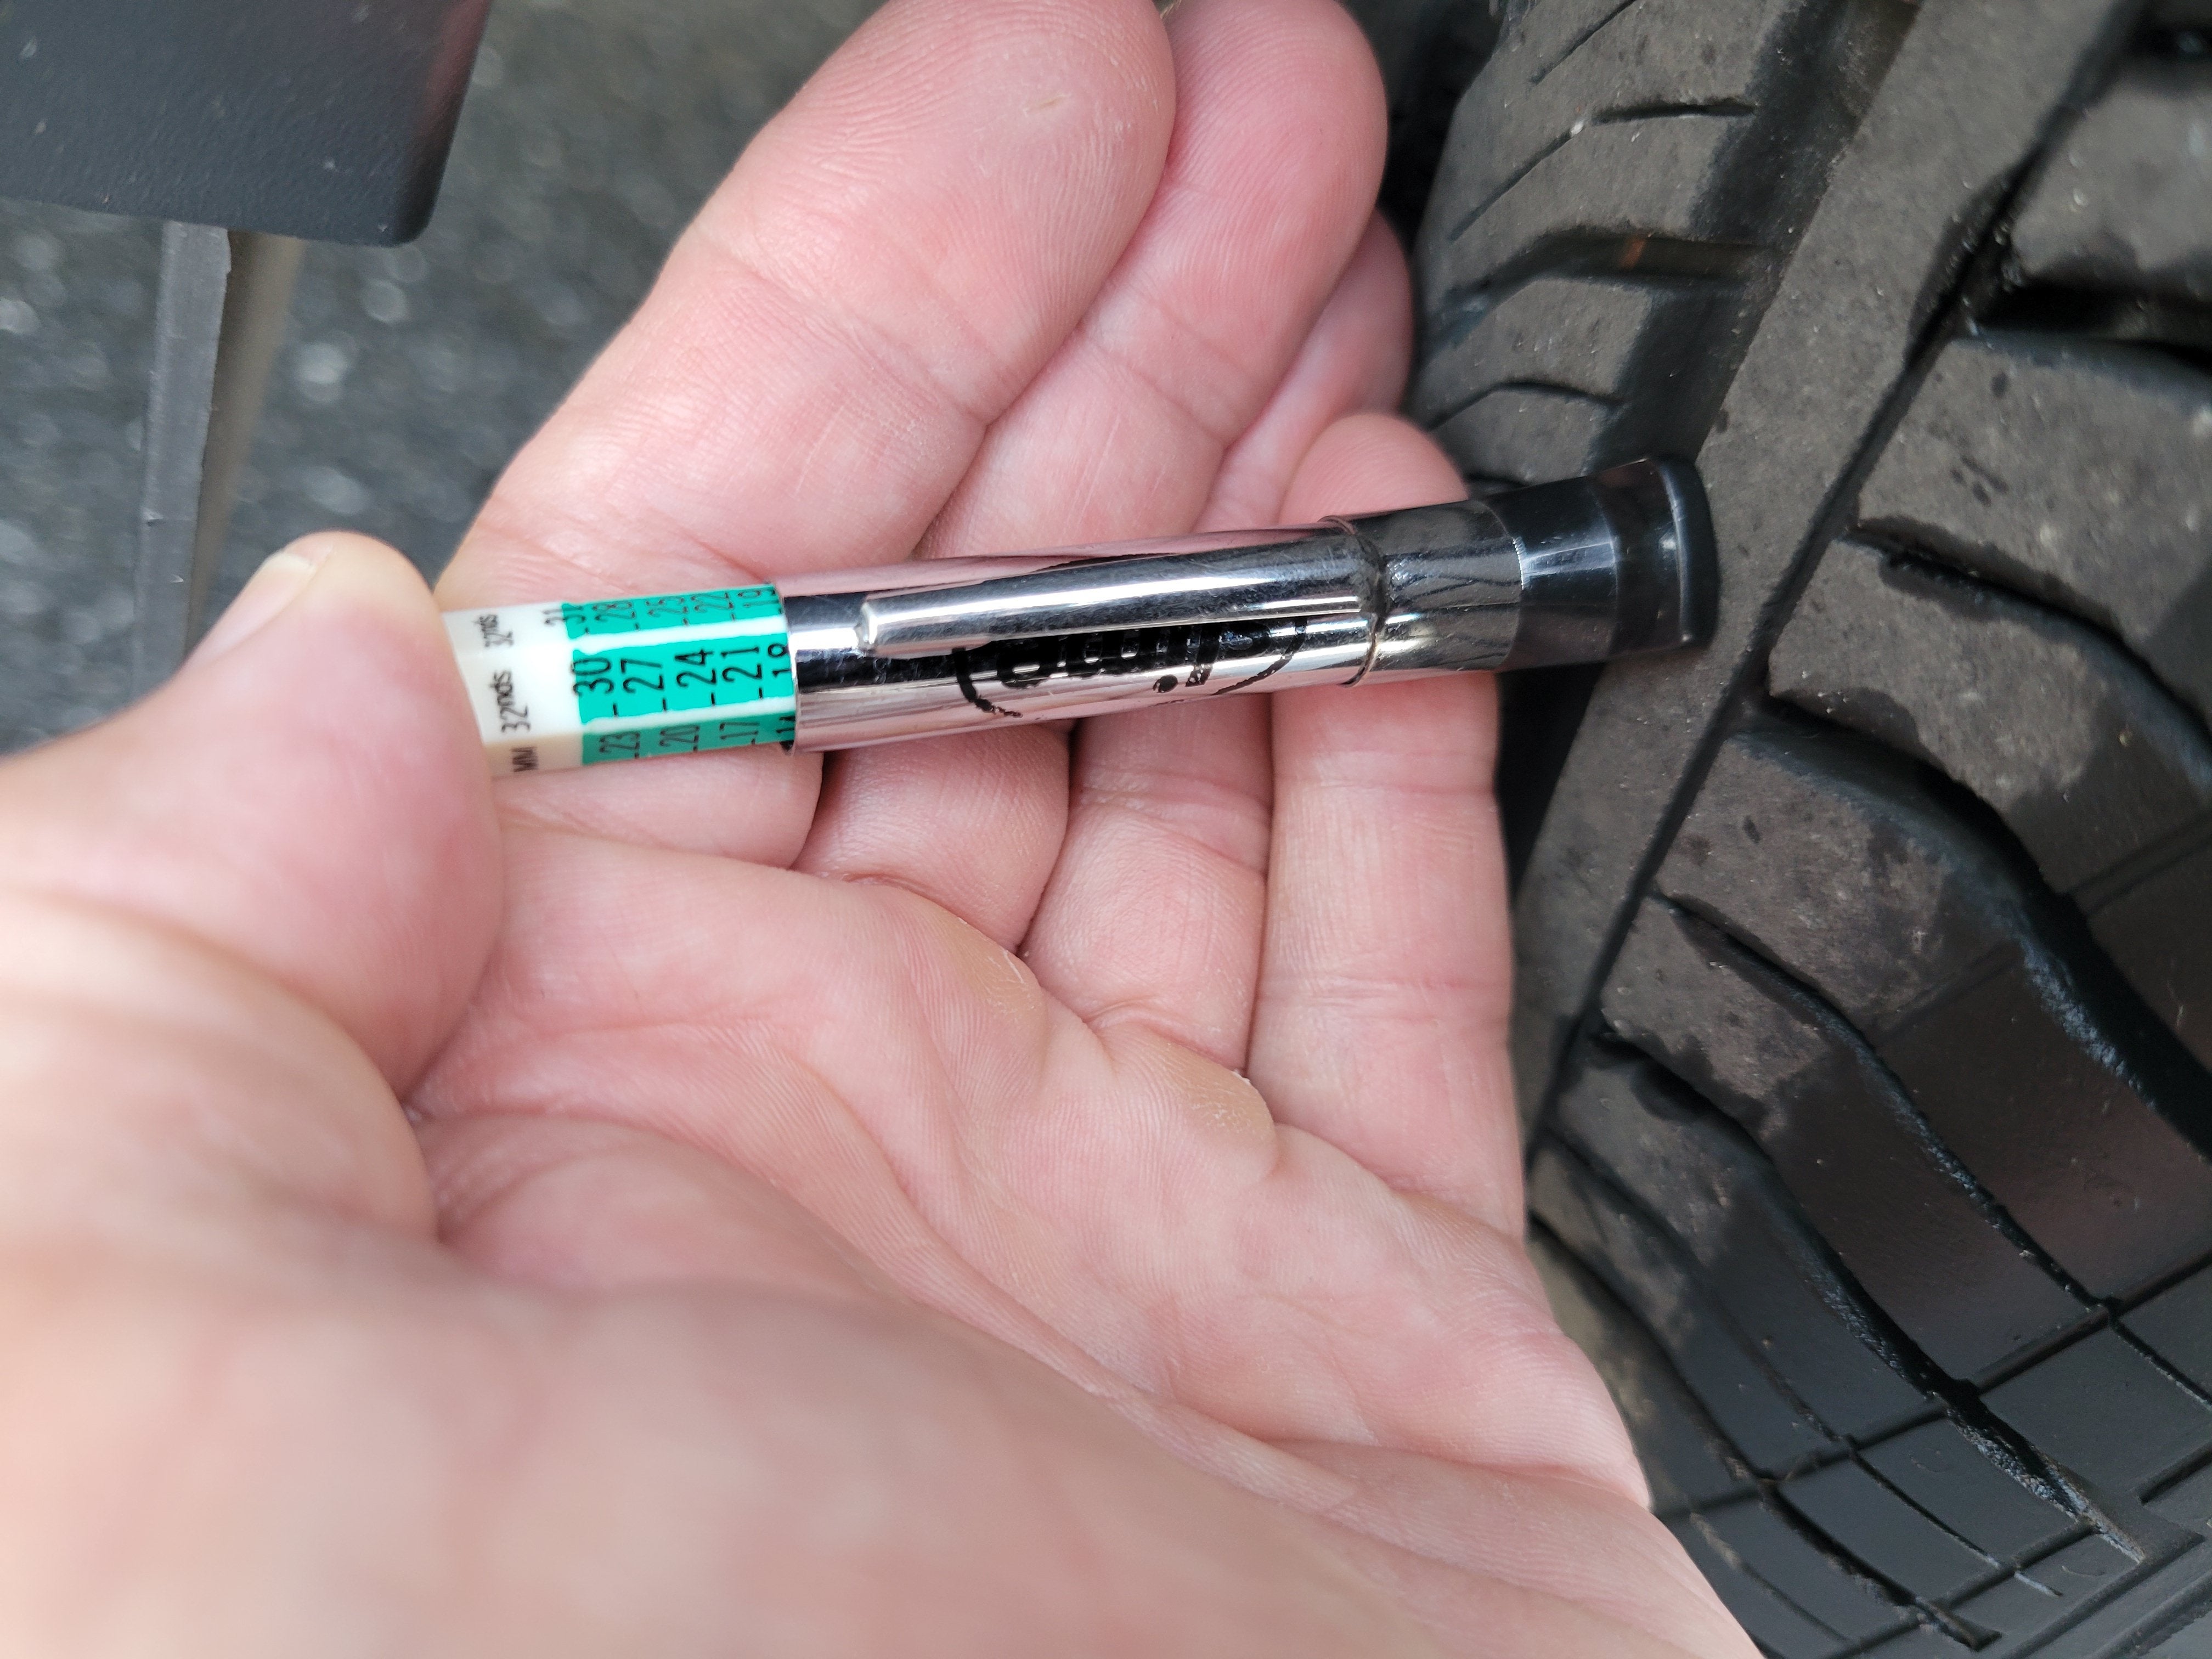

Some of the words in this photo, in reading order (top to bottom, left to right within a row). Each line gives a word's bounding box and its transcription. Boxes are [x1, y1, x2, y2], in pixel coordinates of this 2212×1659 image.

[543, 605, 584, 625] 31
[571, 657, 614, 696] 30
[620, 659, 664, 693] 27
[674, 648, 716, 687] 24
[721, 646, 762, 682] 21
[490, 670, 531, 732] 32nds
[599, 731, 640, 754] 23
[659, 725, 700, 747] 20
[719, 721, 760, 740] 17
[510, 746, 538, 772] MM
